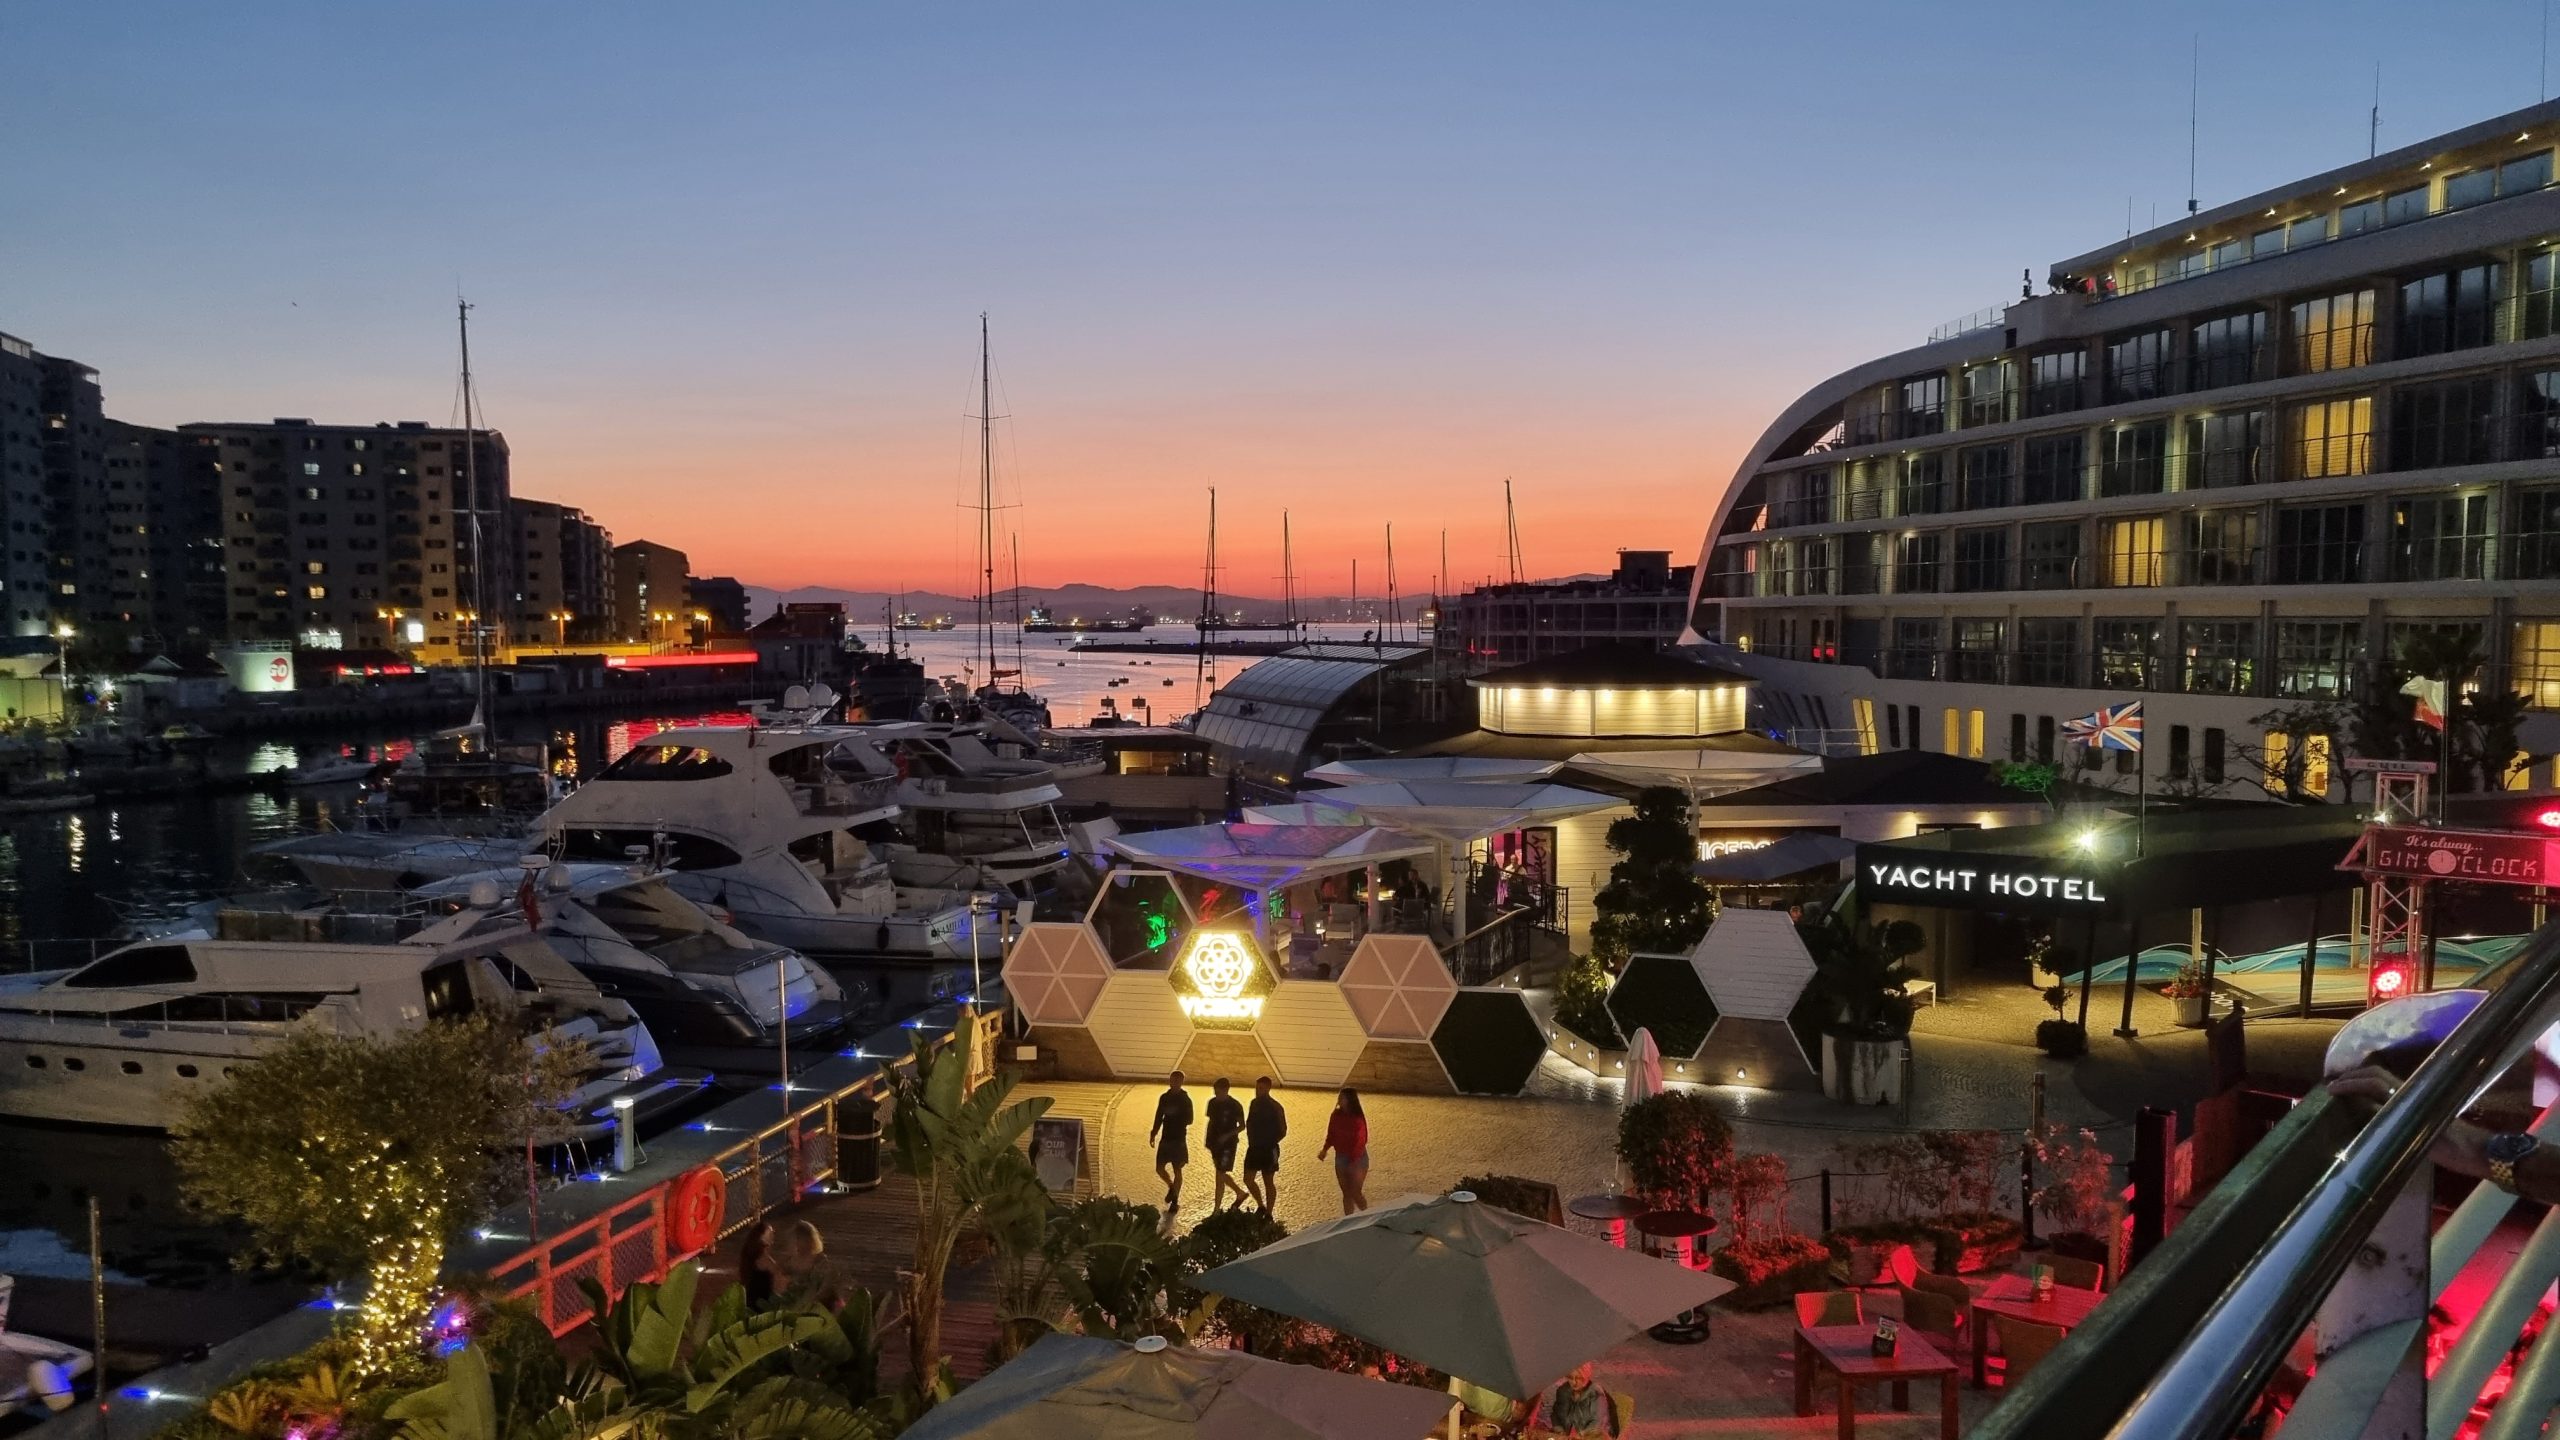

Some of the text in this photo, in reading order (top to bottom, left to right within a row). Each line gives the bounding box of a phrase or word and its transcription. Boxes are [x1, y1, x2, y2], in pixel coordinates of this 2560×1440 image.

[2404, 835, 2428, 847] It's
[1870, 865, 2106, 902] YACHT HOTEL
